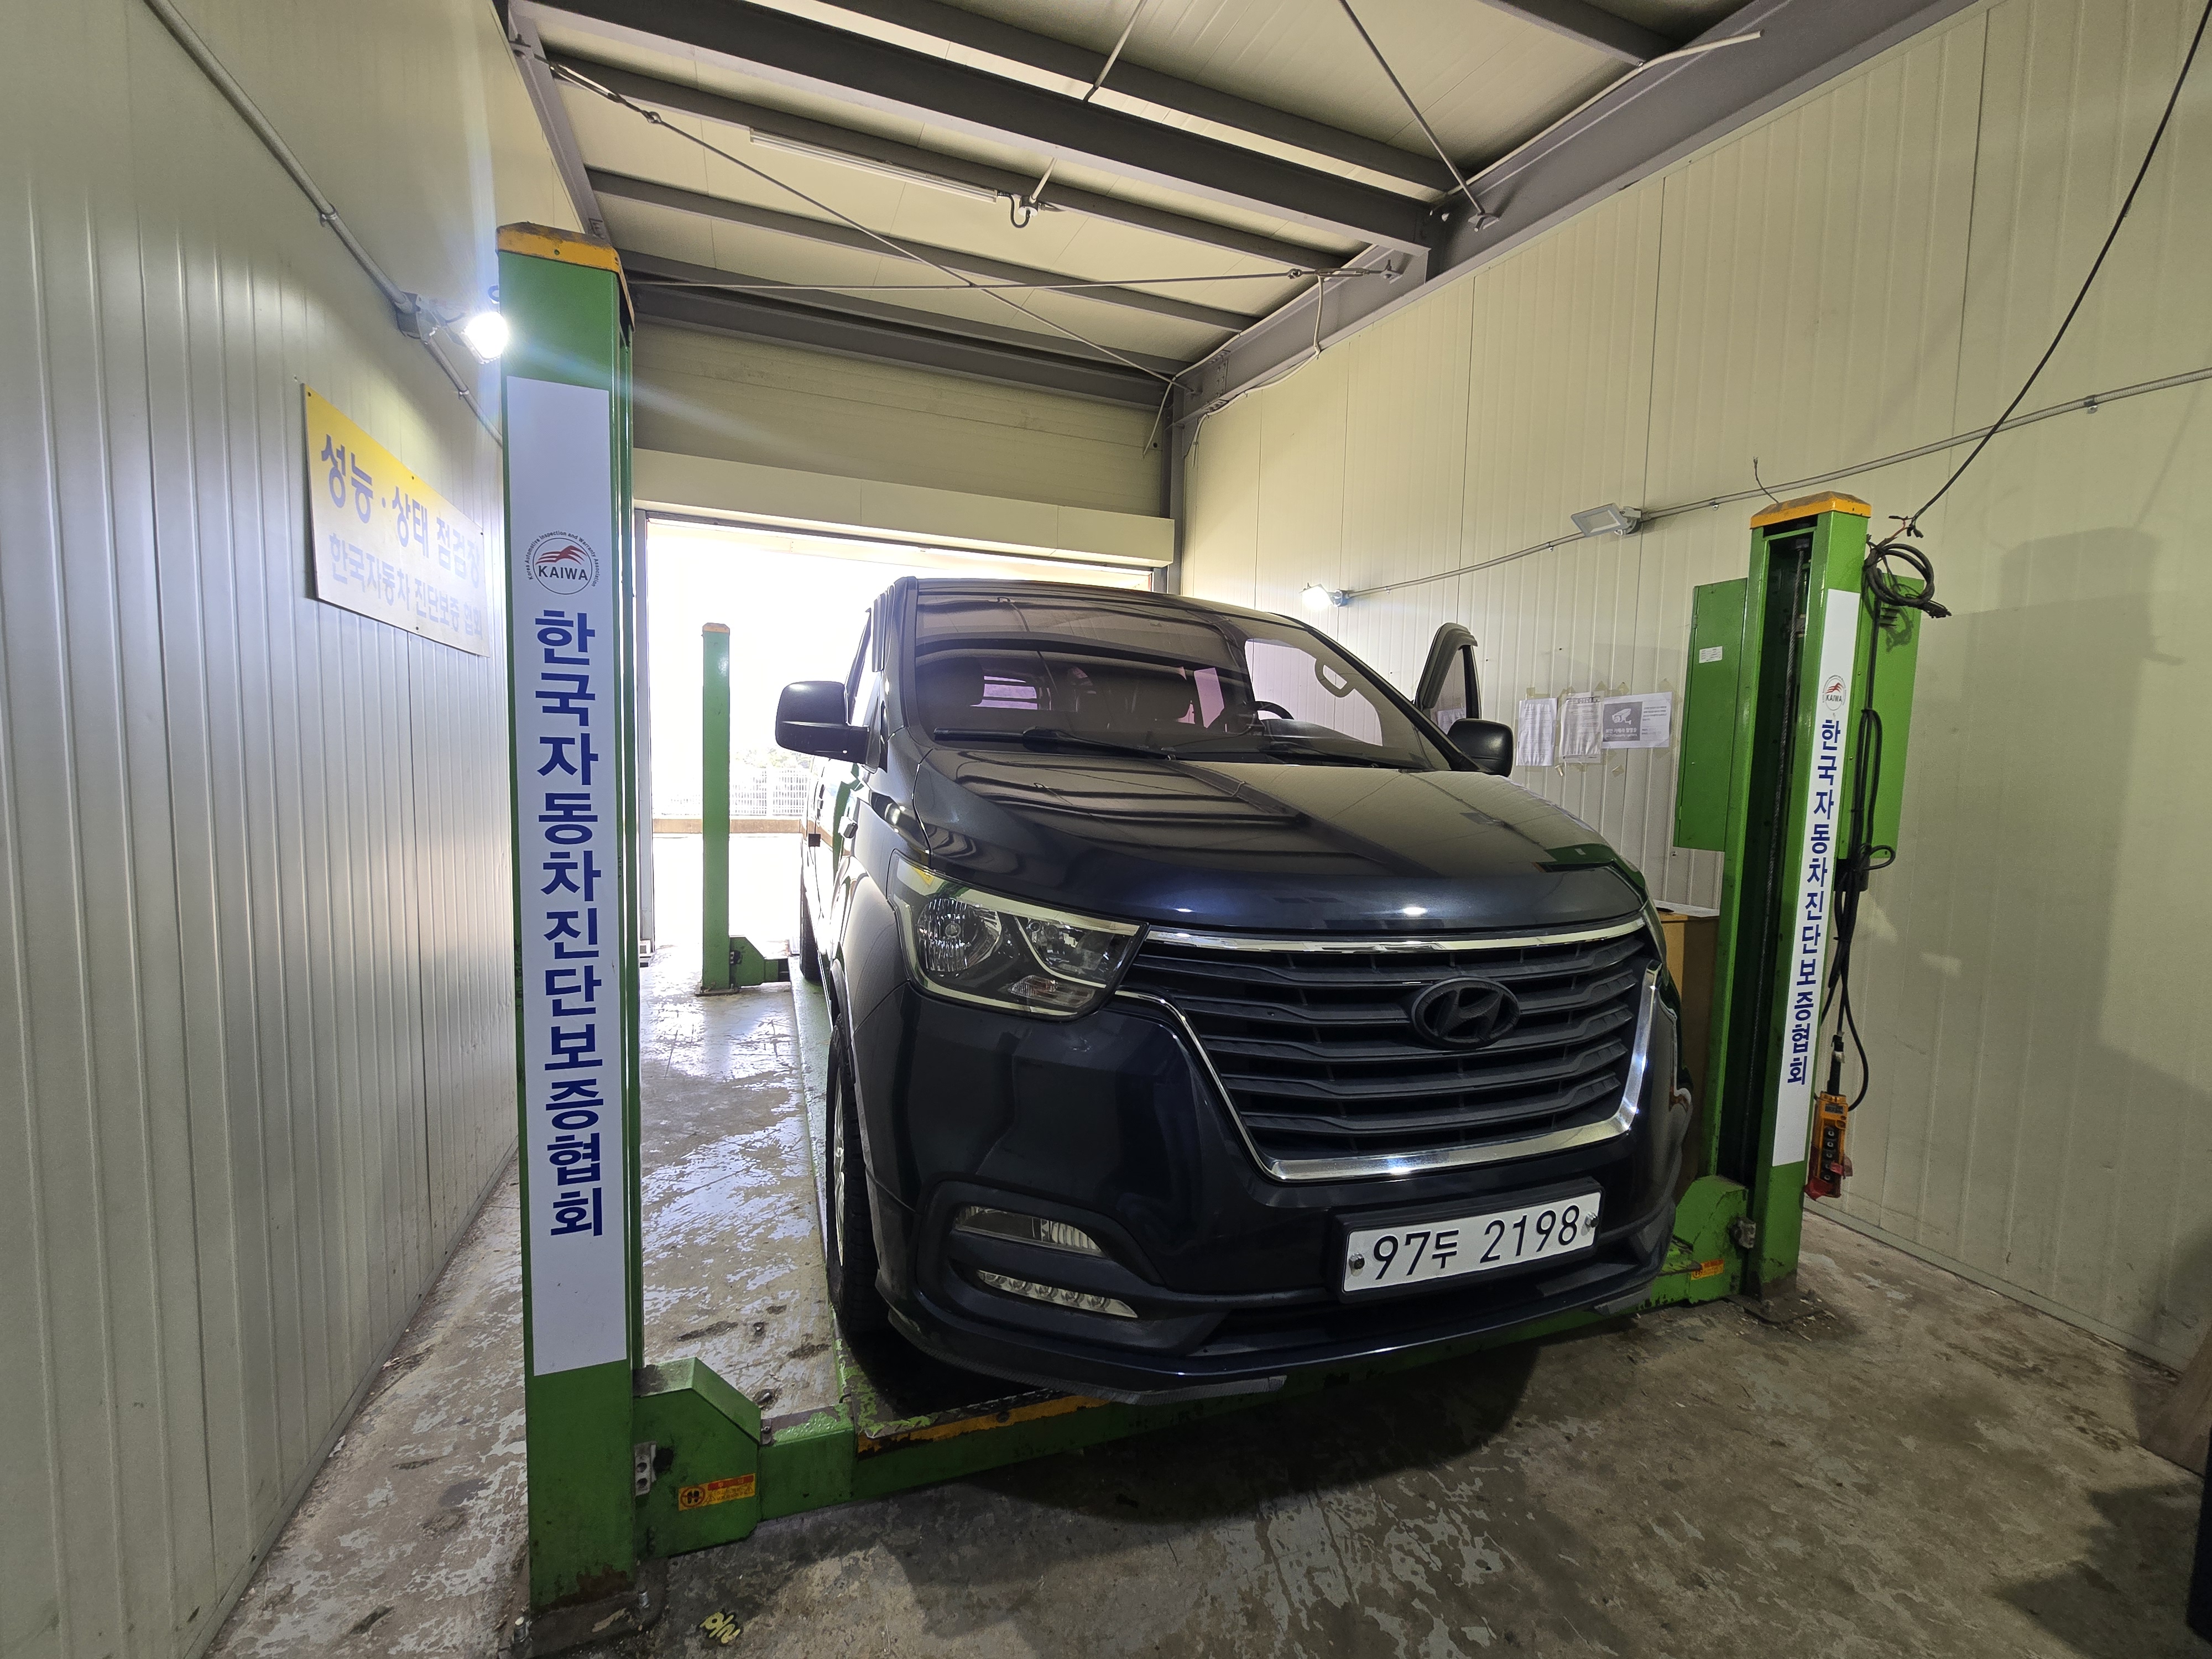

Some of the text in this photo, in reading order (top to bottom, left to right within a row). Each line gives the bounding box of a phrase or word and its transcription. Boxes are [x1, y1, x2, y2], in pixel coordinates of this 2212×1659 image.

[329, 533, 483, 640] 한국자동차 진단보증 협회
[436, 516, 480, 589] 점검장
[525, 539, 540, 564] Automotive
[539, 530, 567, 540] Inspection
[578, 537, 596, 557] Warranty
[591, 559, 600, 587] Association
[538, 565, 588, 581] KAIWA
[535, 609, 604, 1237] 한국자동차진단보증협회
[1787, 719, 1841, 1086] 한국자동차진단보증협회
[1373, 1205, 1580, 1280] 97두 2198
